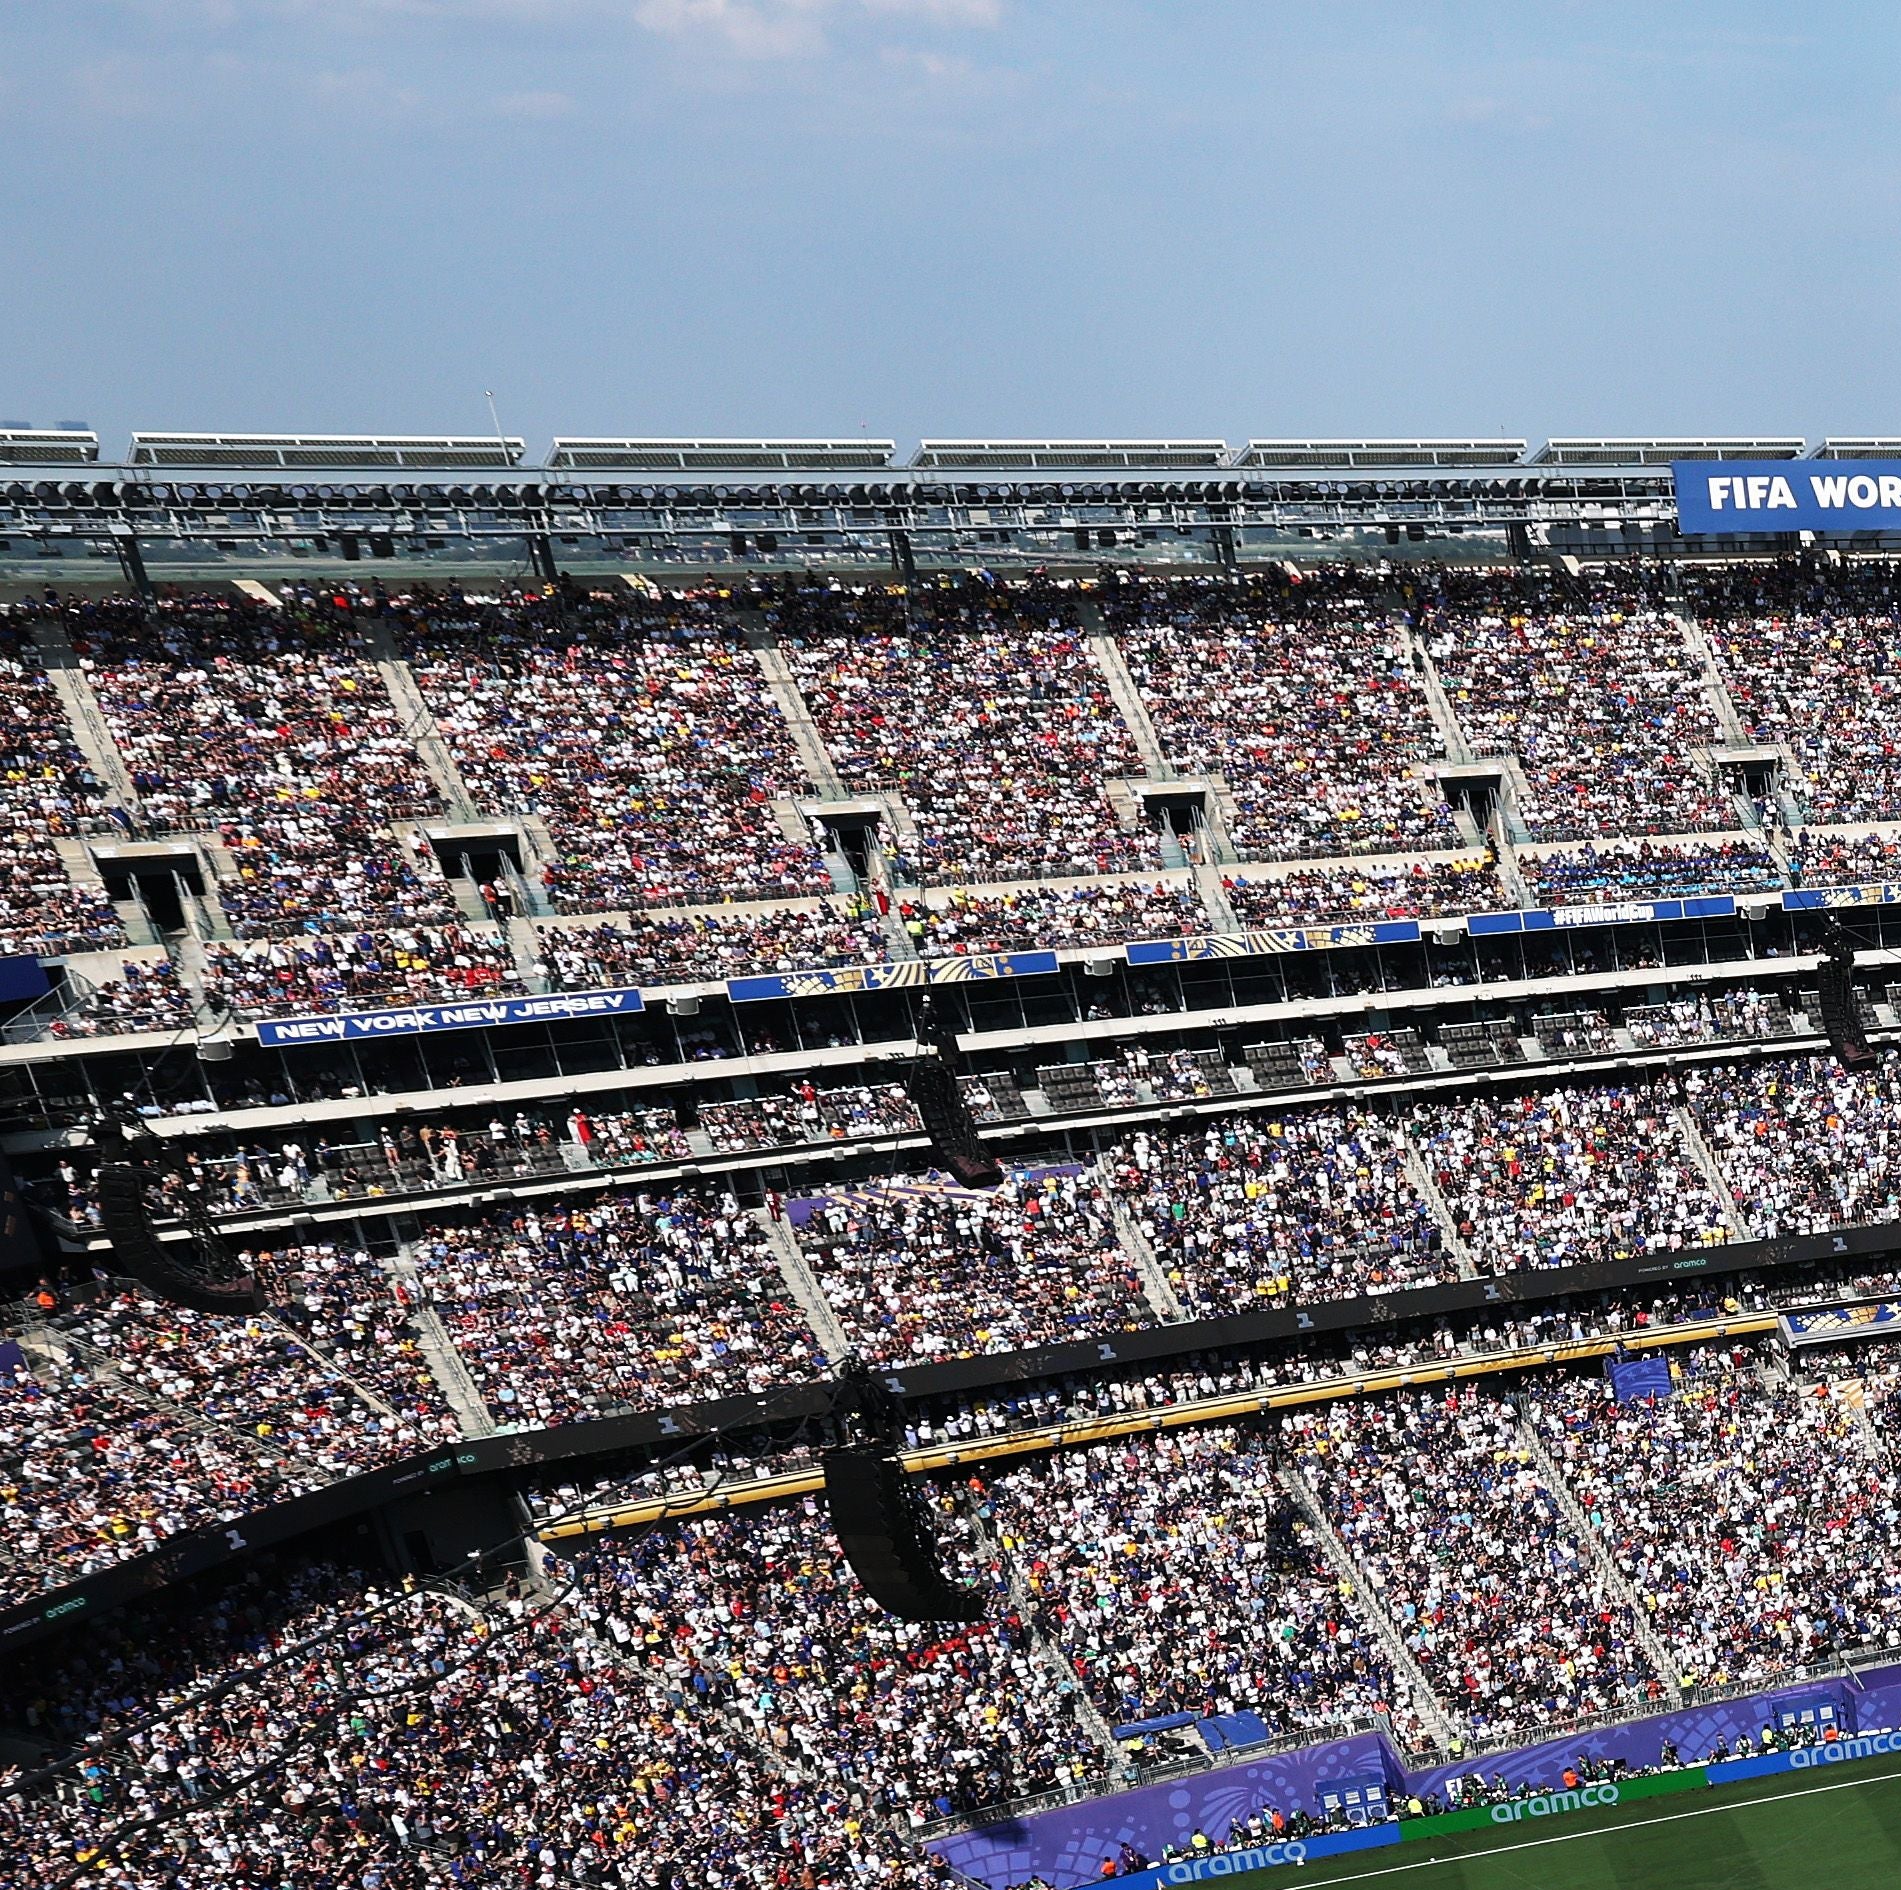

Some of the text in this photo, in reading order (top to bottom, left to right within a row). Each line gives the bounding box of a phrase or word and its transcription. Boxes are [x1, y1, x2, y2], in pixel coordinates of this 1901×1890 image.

[1707, 475, 1798, 510] FIFA
[1552, 903, 1656, 927] #FIFAWorldCup
[274, 993, 625, 1041] NEW YORK NEW JERSEY
[1832, 1236, 1847, 1251] 1
[1673, 1258, 1707, 1269] aramco
[1483, 1282, 1500, 1299] 1
[1296, 1312, 1314, 1328] 1
[1097, 1343, 1116, 1359] 1
[884, 1377, 905, 1392] 1
[657, 1414, 680, 1434] 1
[429, 1454, 475, 1472] aramco
[225, 1529, 246, 1549] 1
[1490, 1785, 1619, 1822] aramco
[1168, 1841, 1306, 1883] aramco
